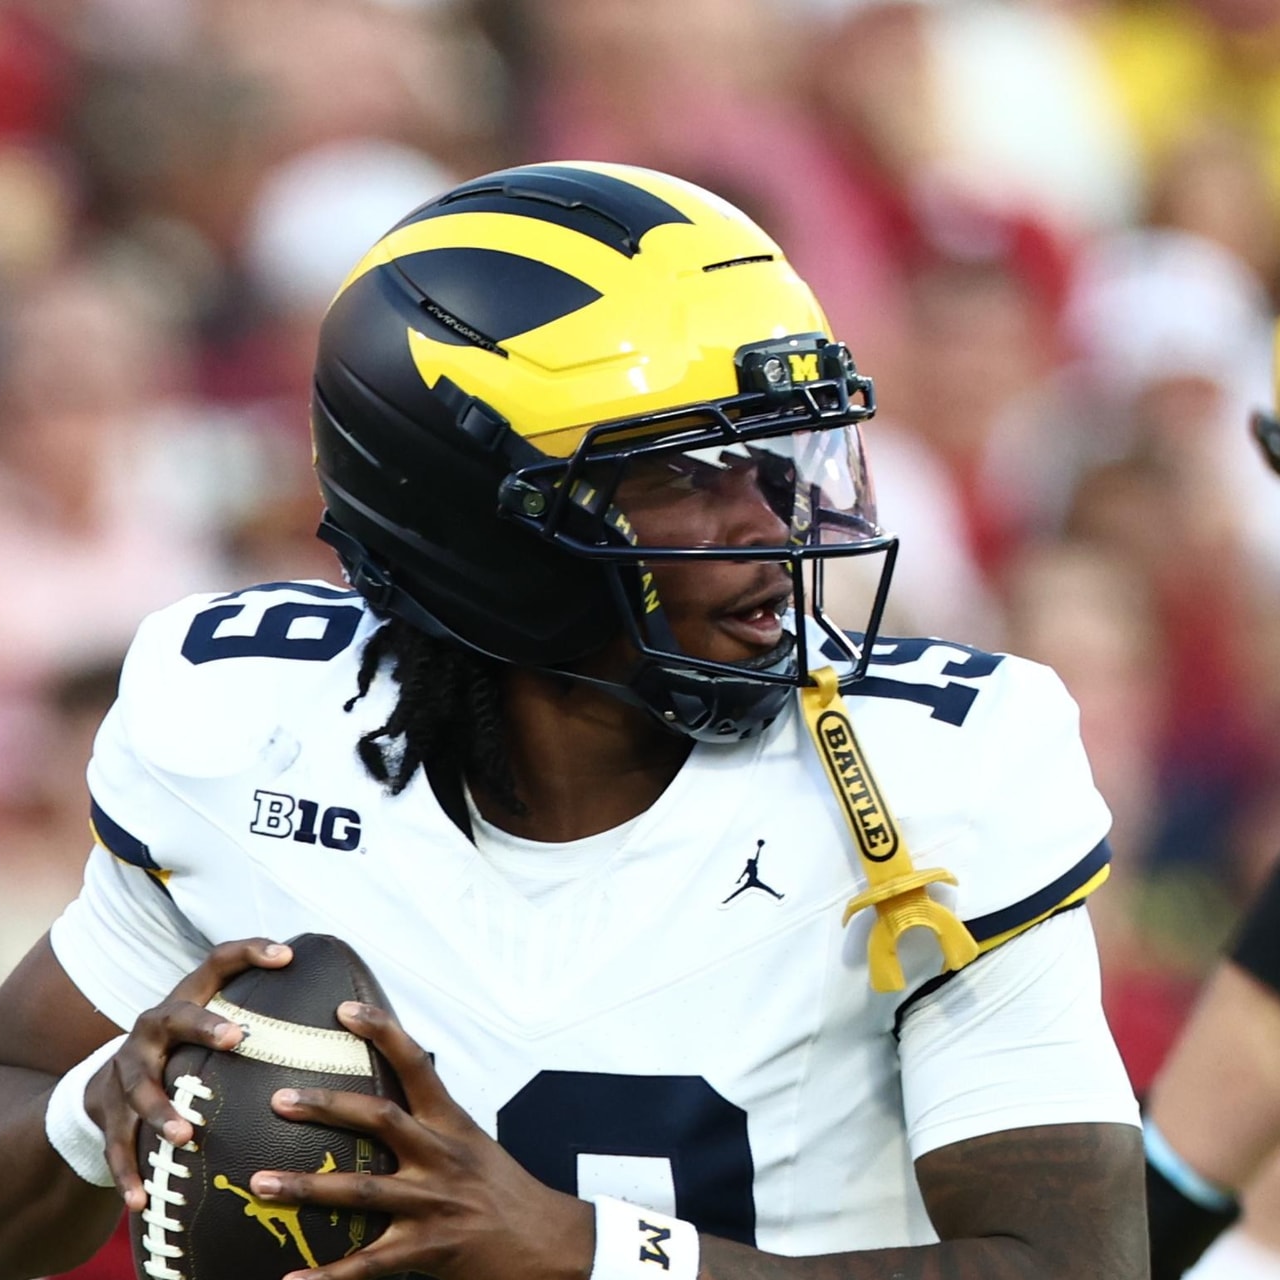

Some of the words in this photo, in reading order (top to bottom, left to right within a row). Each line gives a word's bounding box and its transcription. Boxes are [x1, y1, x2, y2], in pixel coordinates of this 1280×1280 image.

[787, 353, 820, 382] M
[824, 724, 891, 850] BATTLE
[638, 1219, 671, 1271] M
